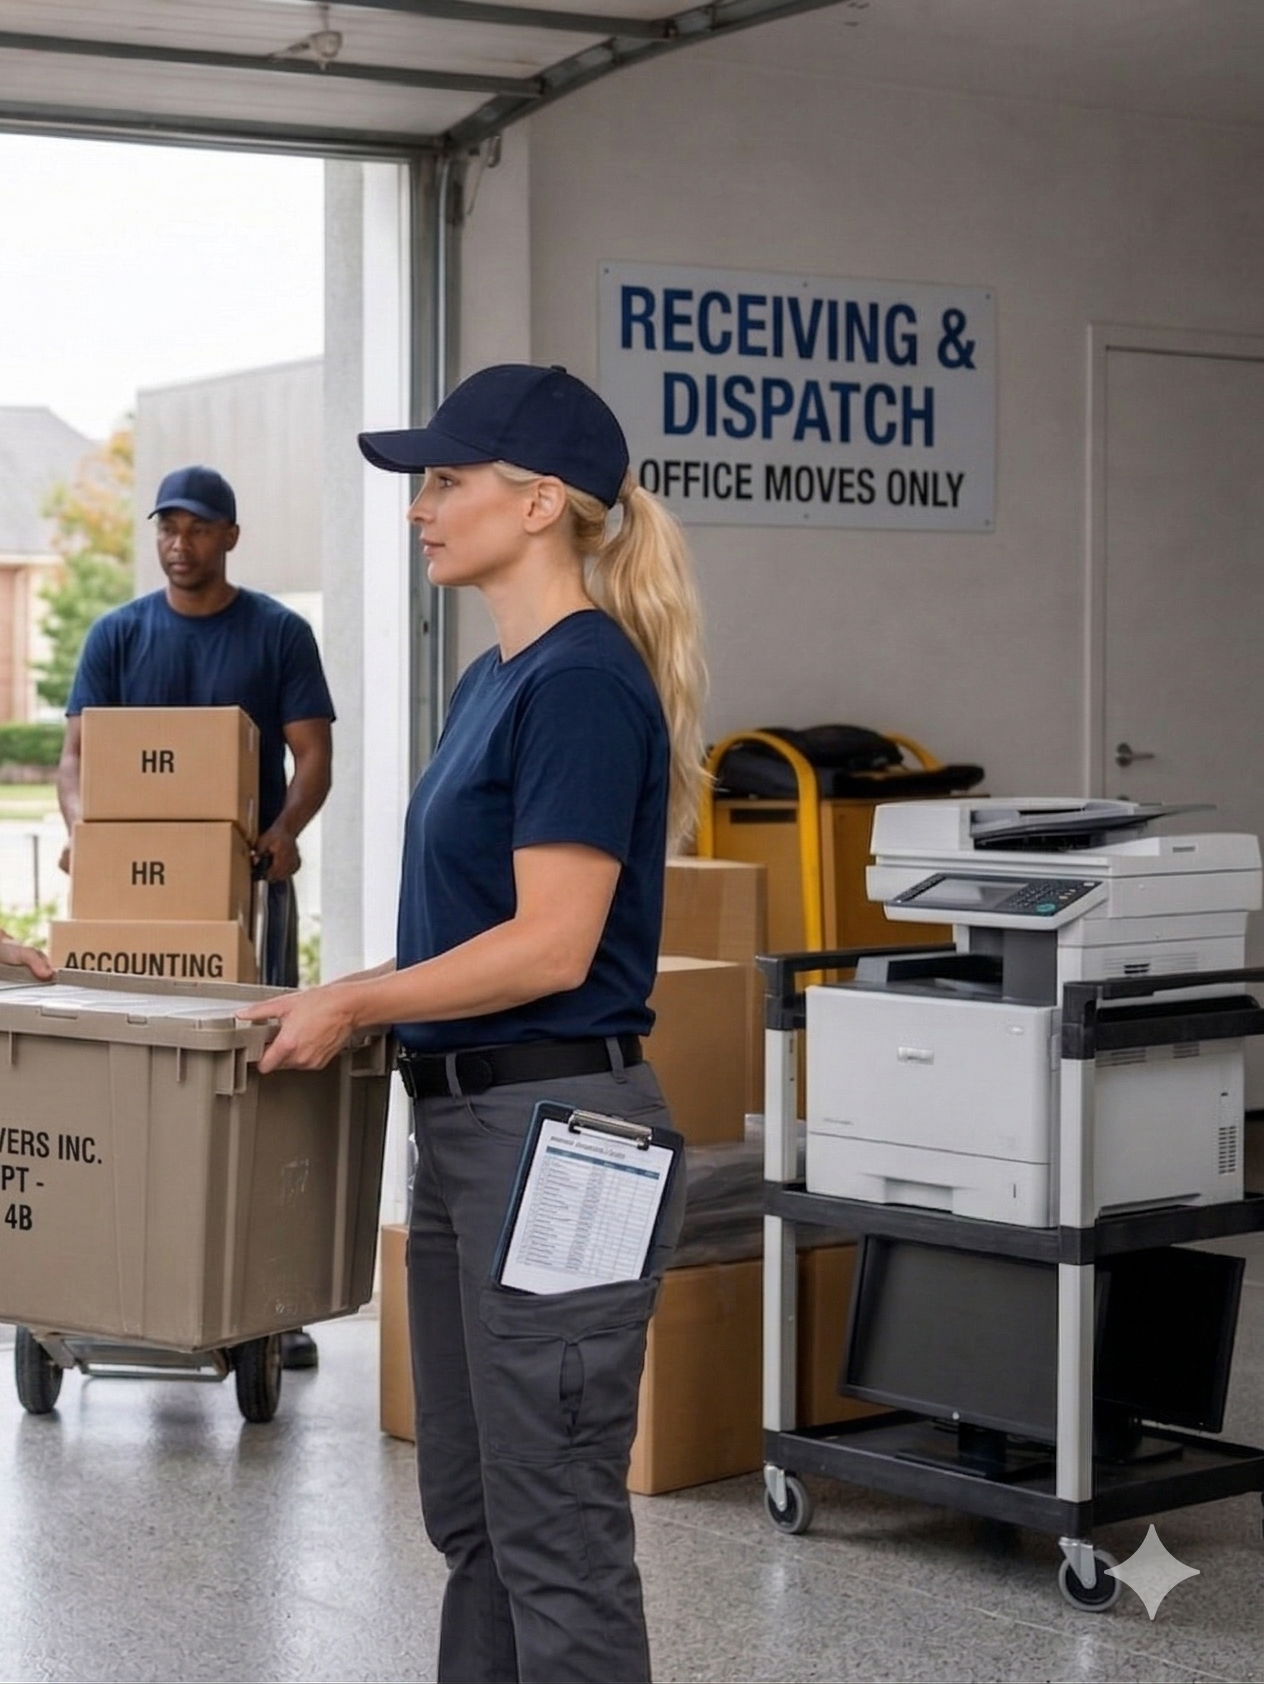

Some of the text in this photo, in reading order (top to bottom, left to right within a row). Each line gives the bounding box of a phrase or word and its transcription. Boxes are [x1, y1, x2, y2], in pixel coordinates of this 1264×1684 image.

[621, 285, 977, 370] RECEIVING &
[663, 371, 935, 448] DISPATCH
[639, 459, 965, 508] OFFICE MOVES ONLY
[142, 750, 174, 773] HR
[132, 861, 165, 885] HR
[65, 952, 223, 978] ACCOUNTING
[58, 1134, 102, 1164] INC.
[5, 1204, 32, 1231] 4B
